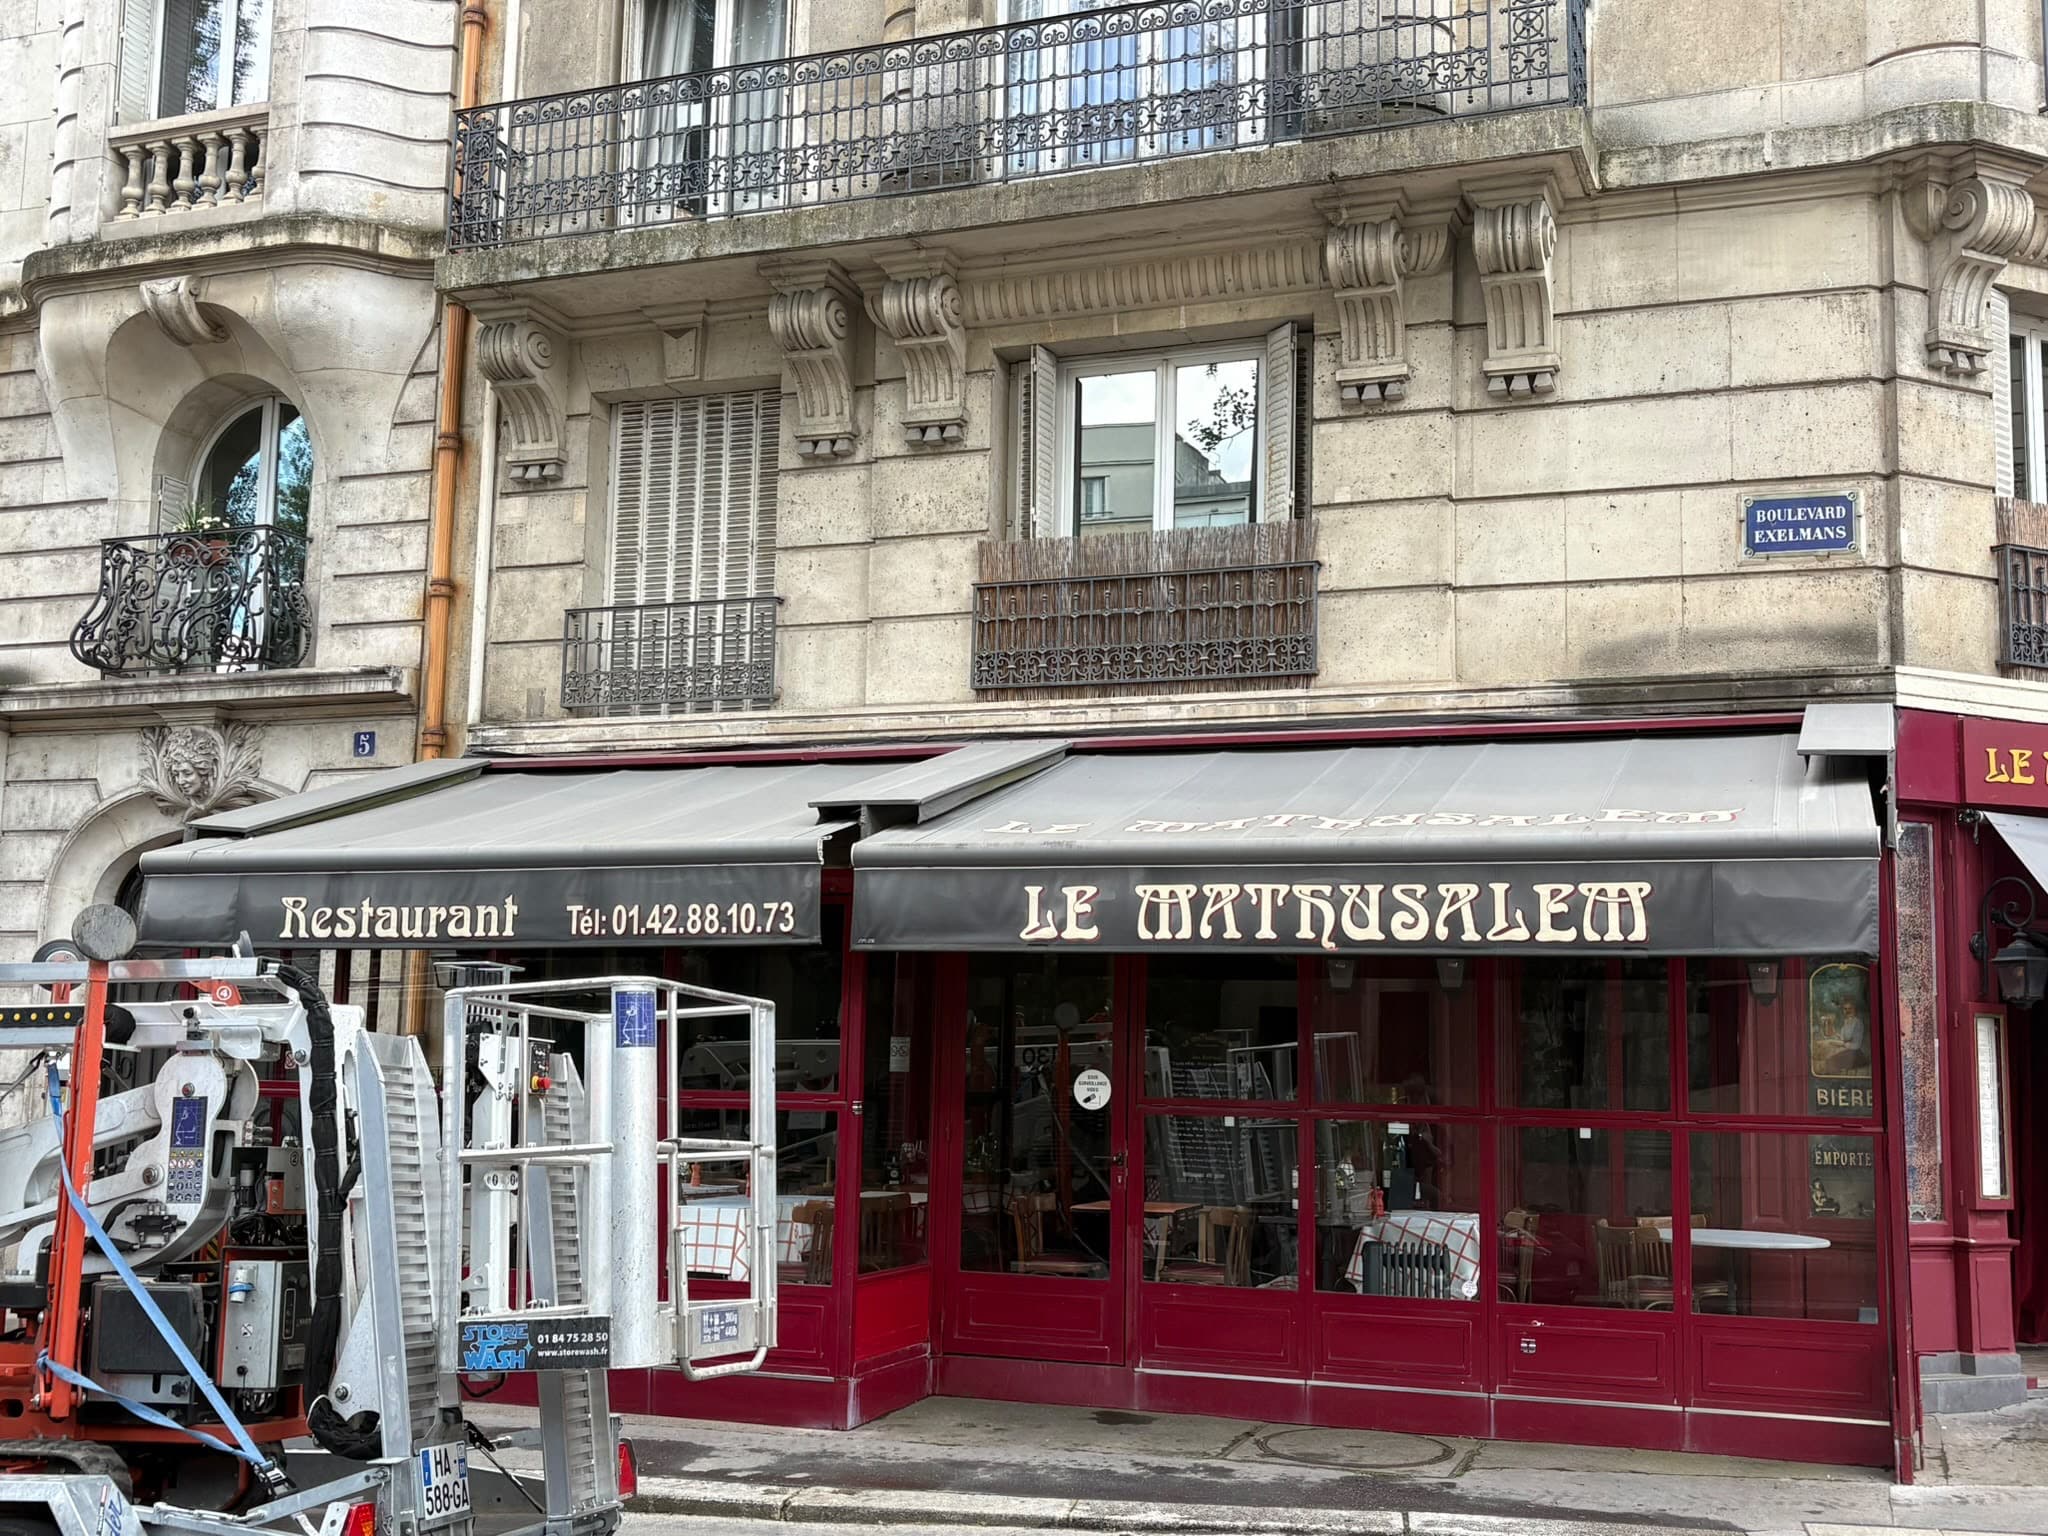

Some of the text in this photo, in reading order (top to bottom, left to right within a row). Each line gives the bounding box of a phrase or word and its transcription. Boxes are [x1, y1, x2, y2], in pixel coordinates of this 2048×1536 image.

[1756, 506, 1846, 523] BOULEVARD
[1754, 526, 1847, 544] EXELMANS
[358, 734, 370, 755] 5
[1985, 748, 2035, 785] LE
[983, 820, 1094, 834] LE
[279, 894, 795, 939] Restaurant Tél: 01.42.88.10.73
[1019, 881, 1653, 951] LE MATHUSALEM
[462, 1323, 528, 1341] STORE
[537, 1332, 608, 1344] 01 84 75 28 50
[464, 1350, 525, 1369] WASH
[537, 1346, 608, 1357] www.storewash.fr
